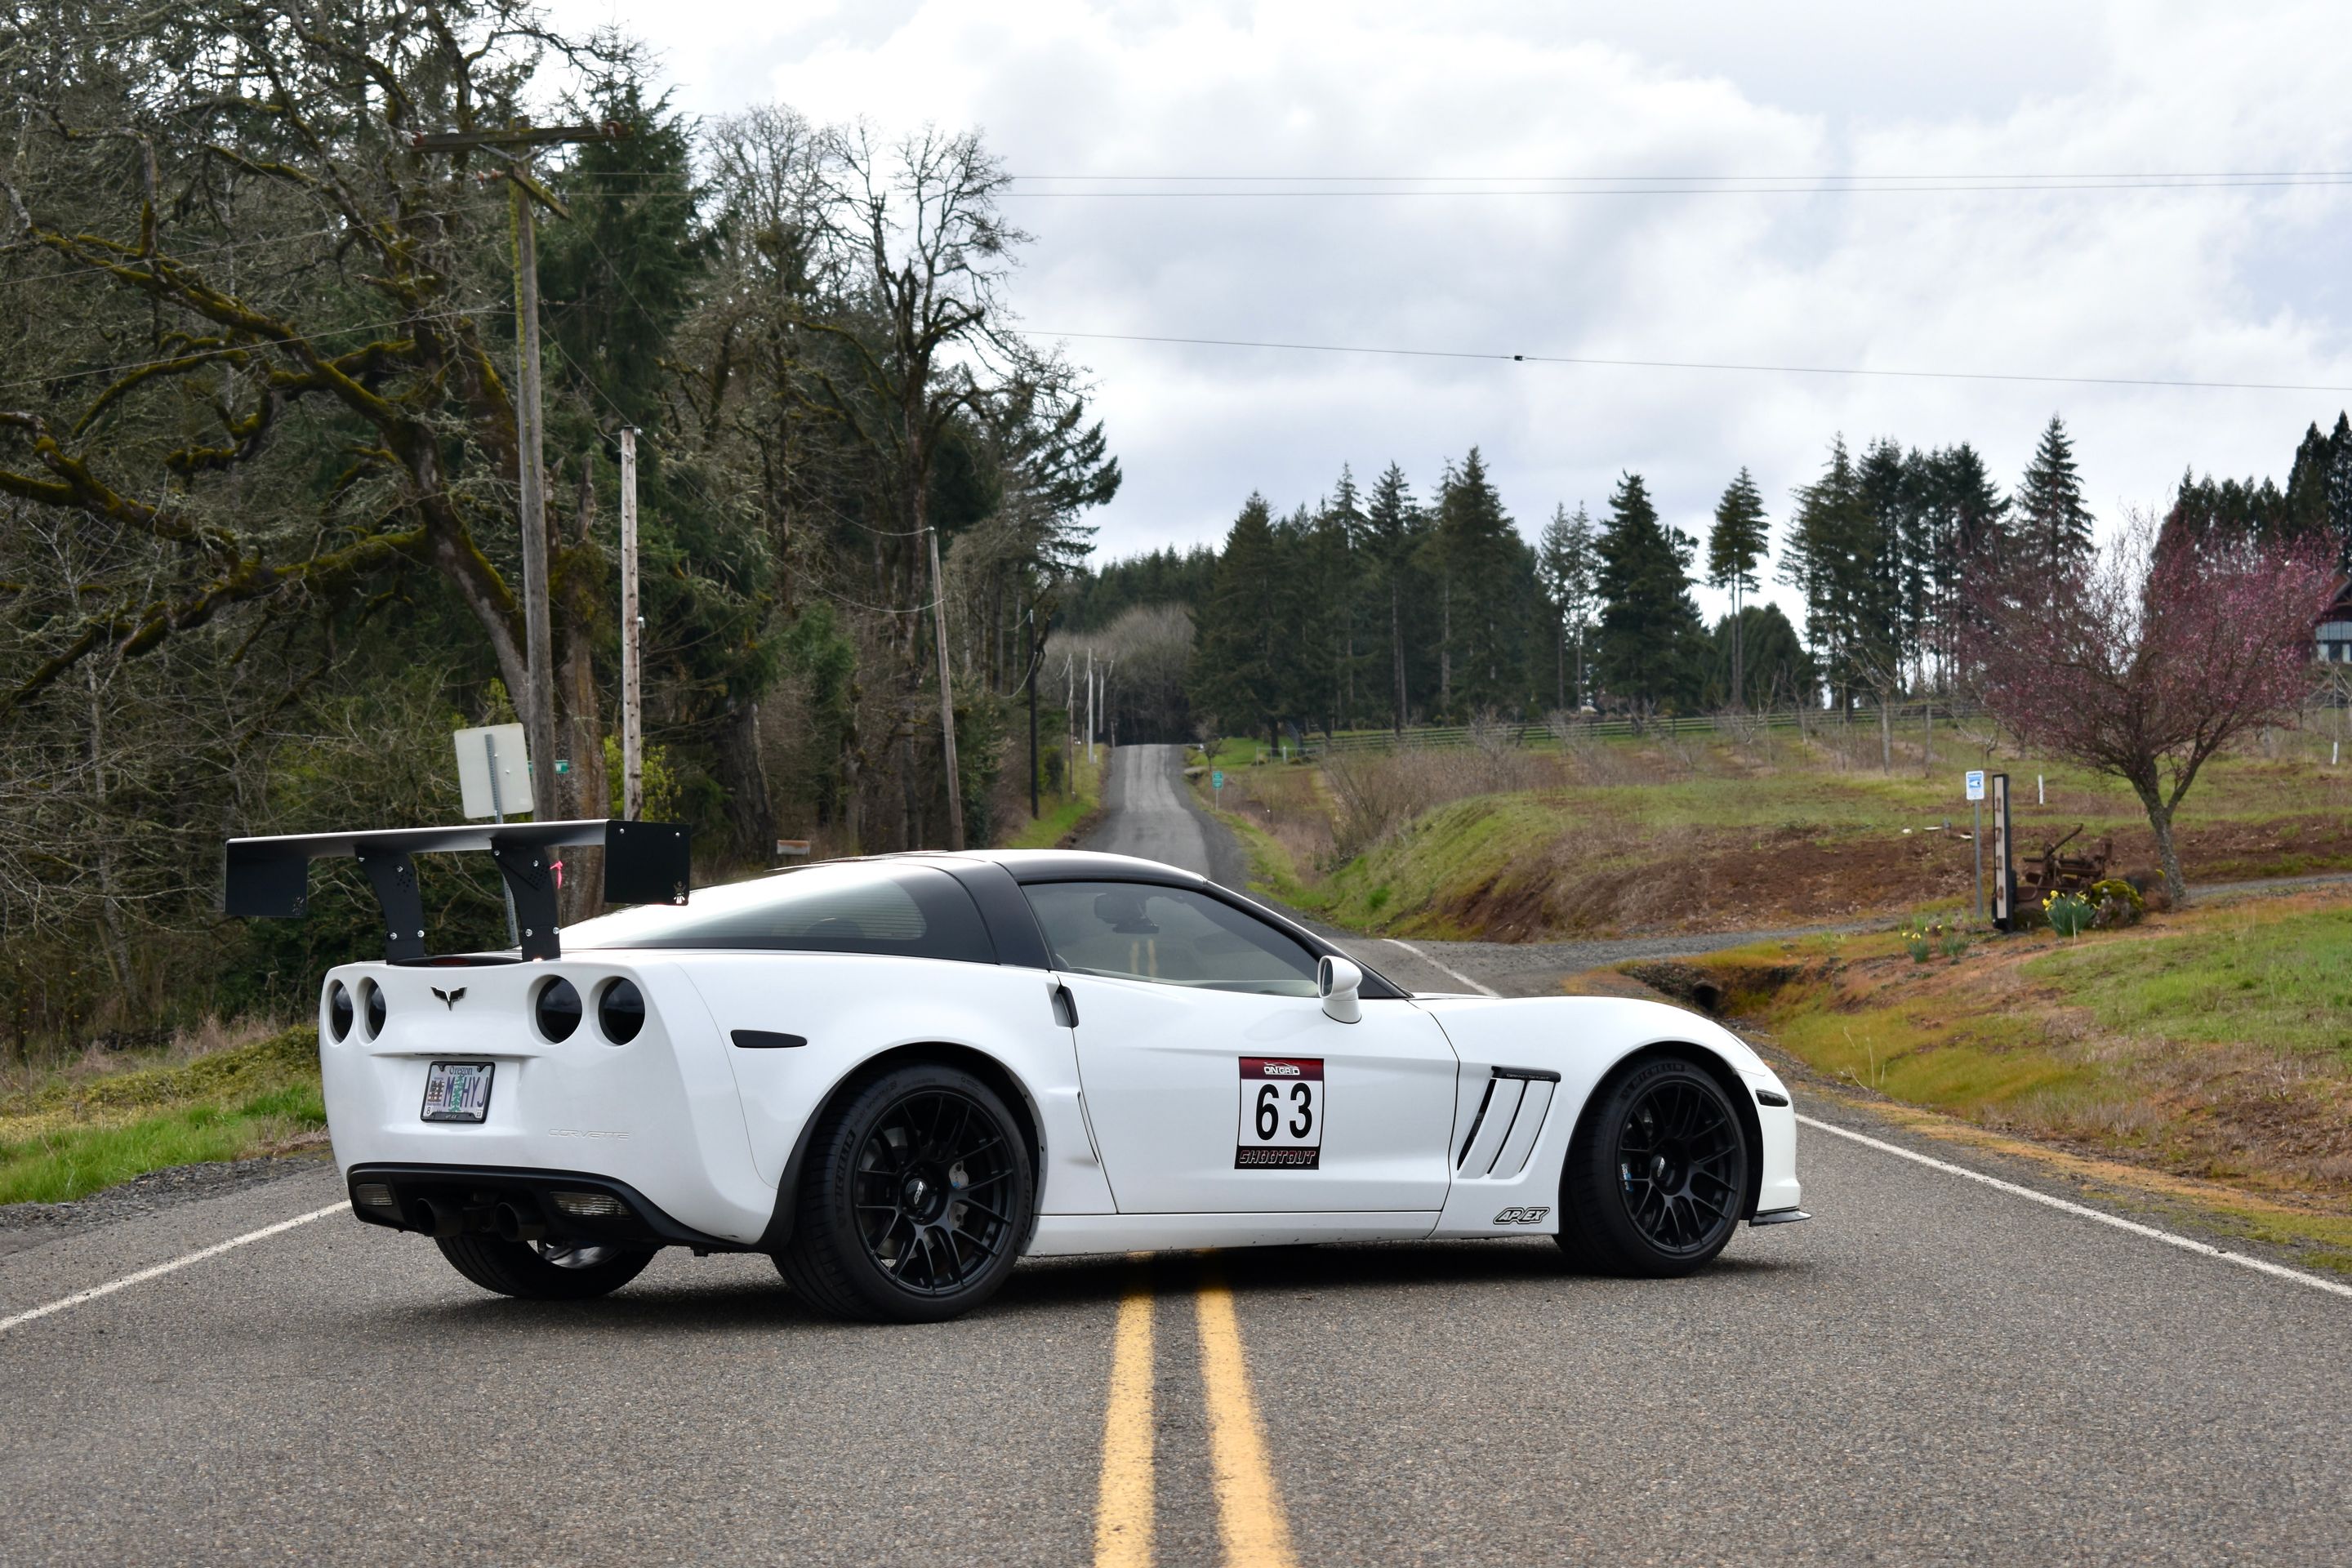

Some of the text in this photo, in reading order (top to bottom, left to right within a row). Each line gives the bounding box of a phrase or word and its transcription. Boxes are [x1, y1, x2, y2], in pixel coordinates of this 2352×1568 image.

[449, 1066, 473, 1077] Oregon
[1255, 1082, 1312, 1141] 63
[1239, 1150, 1316, 1165] SHOOTOUT
[835, 1129, 856, 1210] MICHELIN
[1494, 1208, 1549, 1224] APEX
